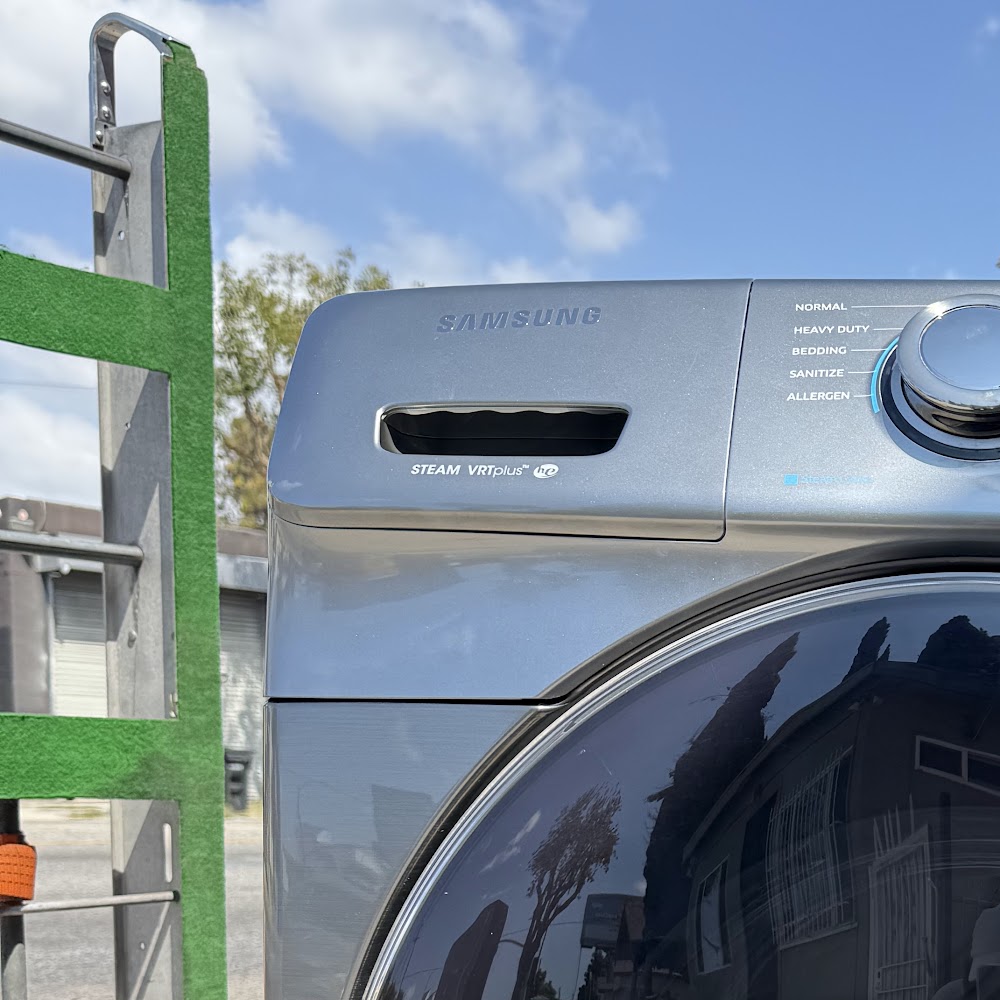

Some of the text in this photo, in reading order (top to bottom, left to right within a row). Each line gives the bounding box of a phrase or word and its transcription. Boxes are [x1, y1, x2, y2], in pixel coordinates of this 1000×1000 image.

[795, 303, 847, 311] NORMAL
[437, 307, 601, 332] SAMSUNG
[793, 325, 870, 334] HEAVY DUTY
[792, 346, 847, 355] BEDDING
[789, 369, 845, 378] SANITIZE
[786, 392, 850, 401] ALLERGEN
[410, 464, 461, 475] STEAM
